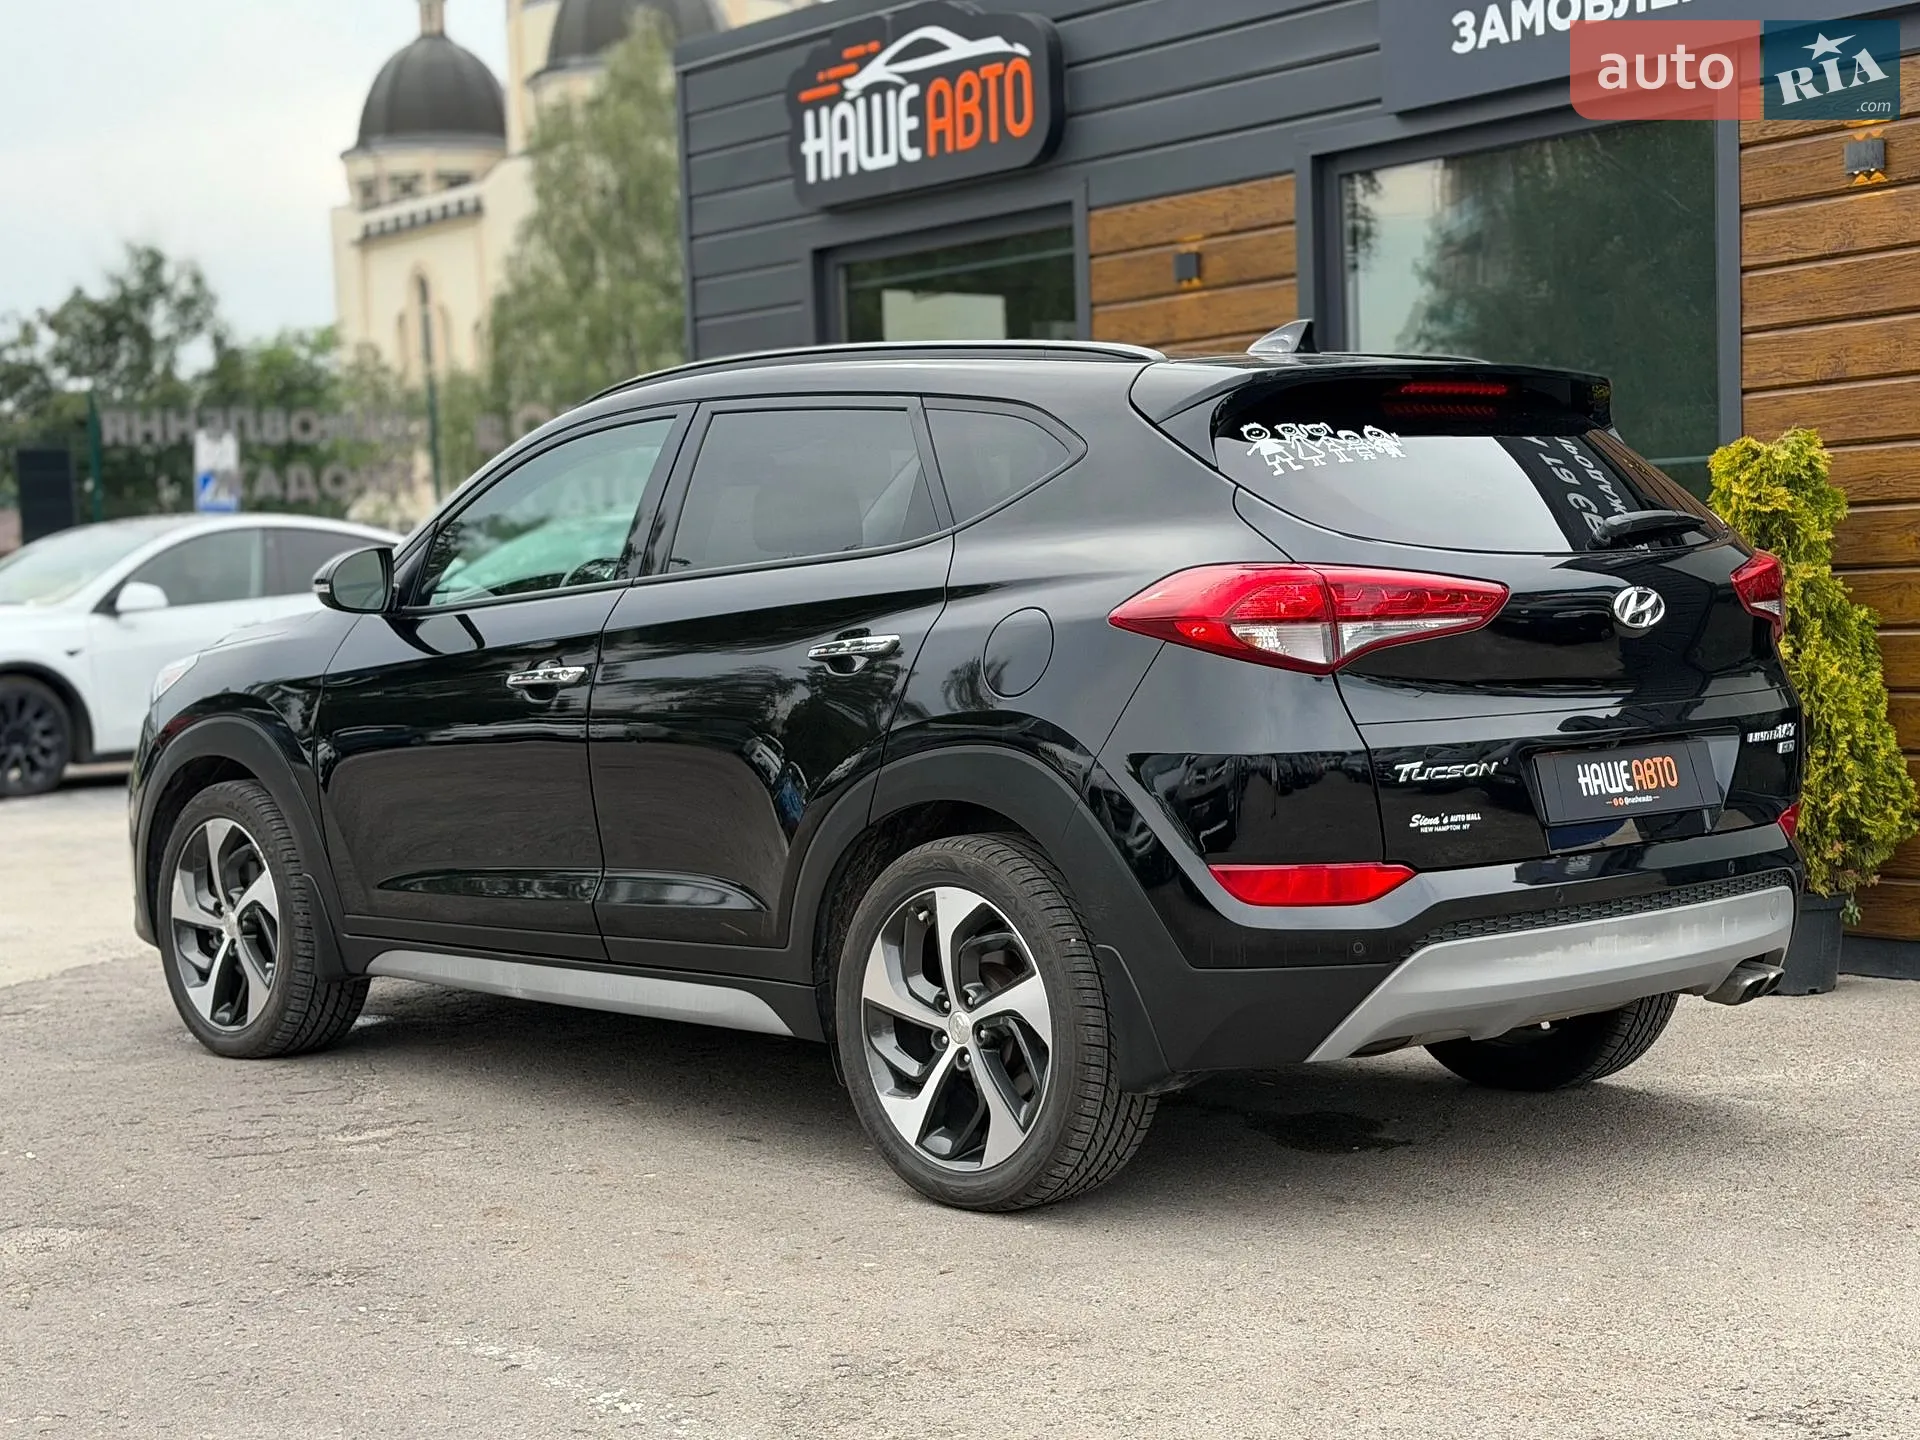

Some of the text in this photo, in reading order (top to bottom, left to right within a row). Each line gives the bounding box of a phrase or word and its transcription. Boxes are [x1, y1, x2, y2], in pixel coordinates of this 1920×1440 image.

[1451, 0, 1693, 54] ЗАМОВ
[801, 57, 1034, 184] НАШЕ АВТО
[1394, 761, 1498, 782] TUCSON
[1577, 756, 1678, 796] НАШЕ АВТО
[1434, 824, 1460, 832] HAMPTON
[1462, 823, 1470, 831] NY
[1450, 814, 1465, 822] AUTO
[1466, 812, 1481, 821] MALL
